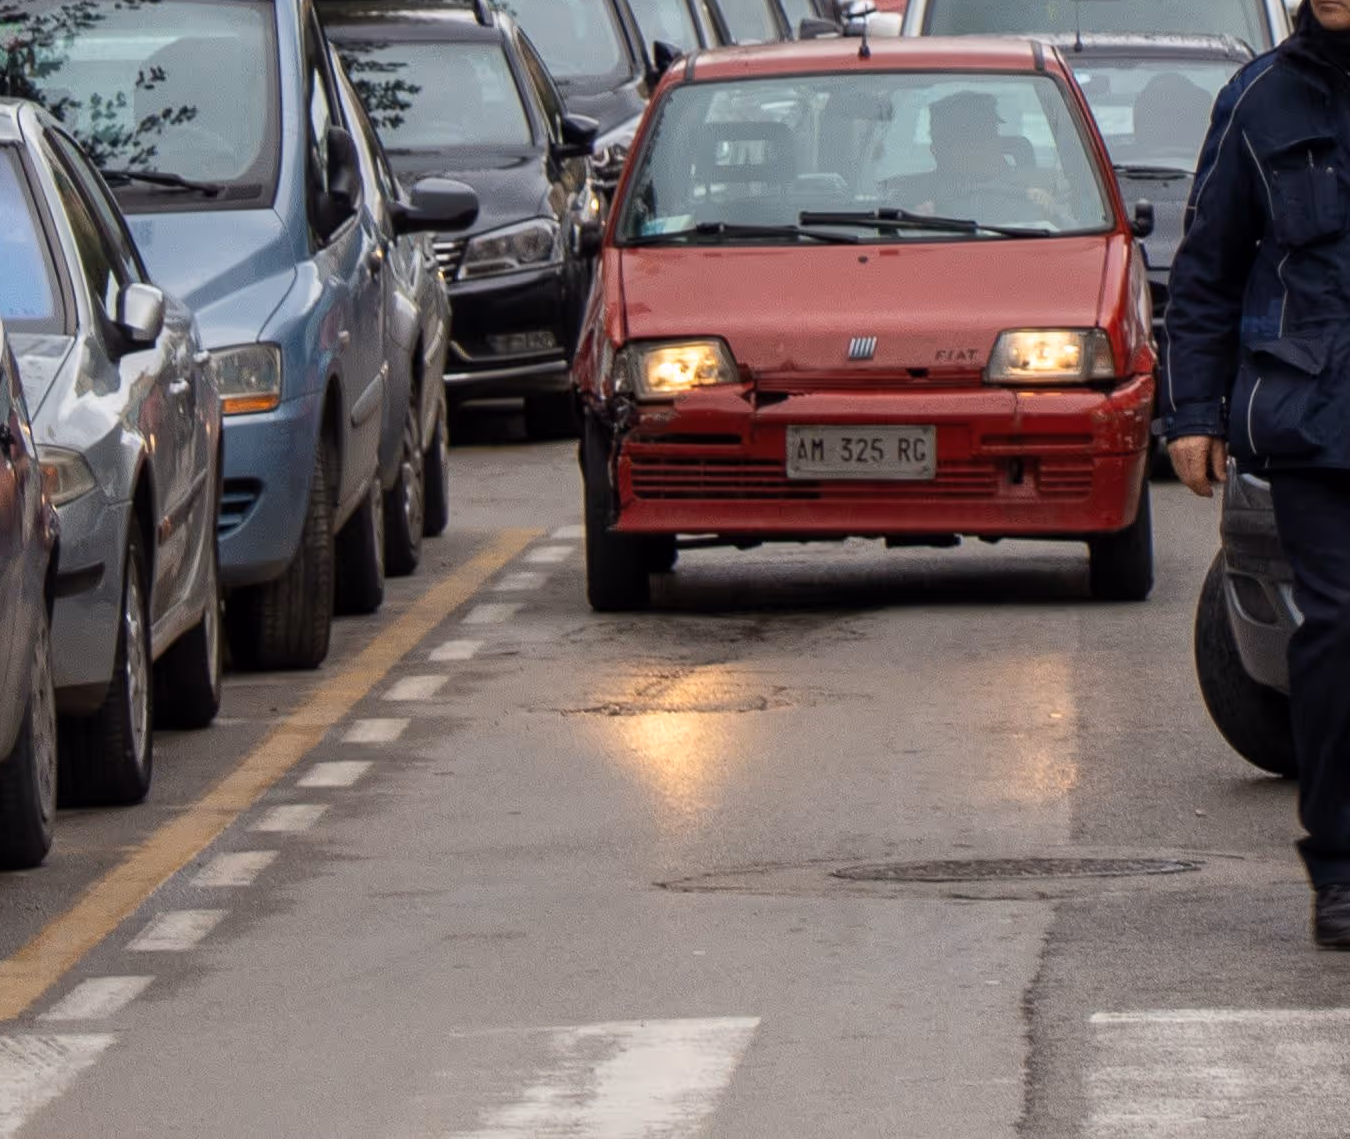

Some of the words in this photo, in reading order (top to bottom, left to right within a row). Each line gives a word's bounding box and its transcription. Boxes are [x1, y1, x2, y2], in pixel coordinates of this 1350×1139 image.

[935, 349, 978, 361] FIAT
[797, 437, 825, 461] AM
[840, 437, 884, 463] 325
[897, 437, 926, 462] RG
